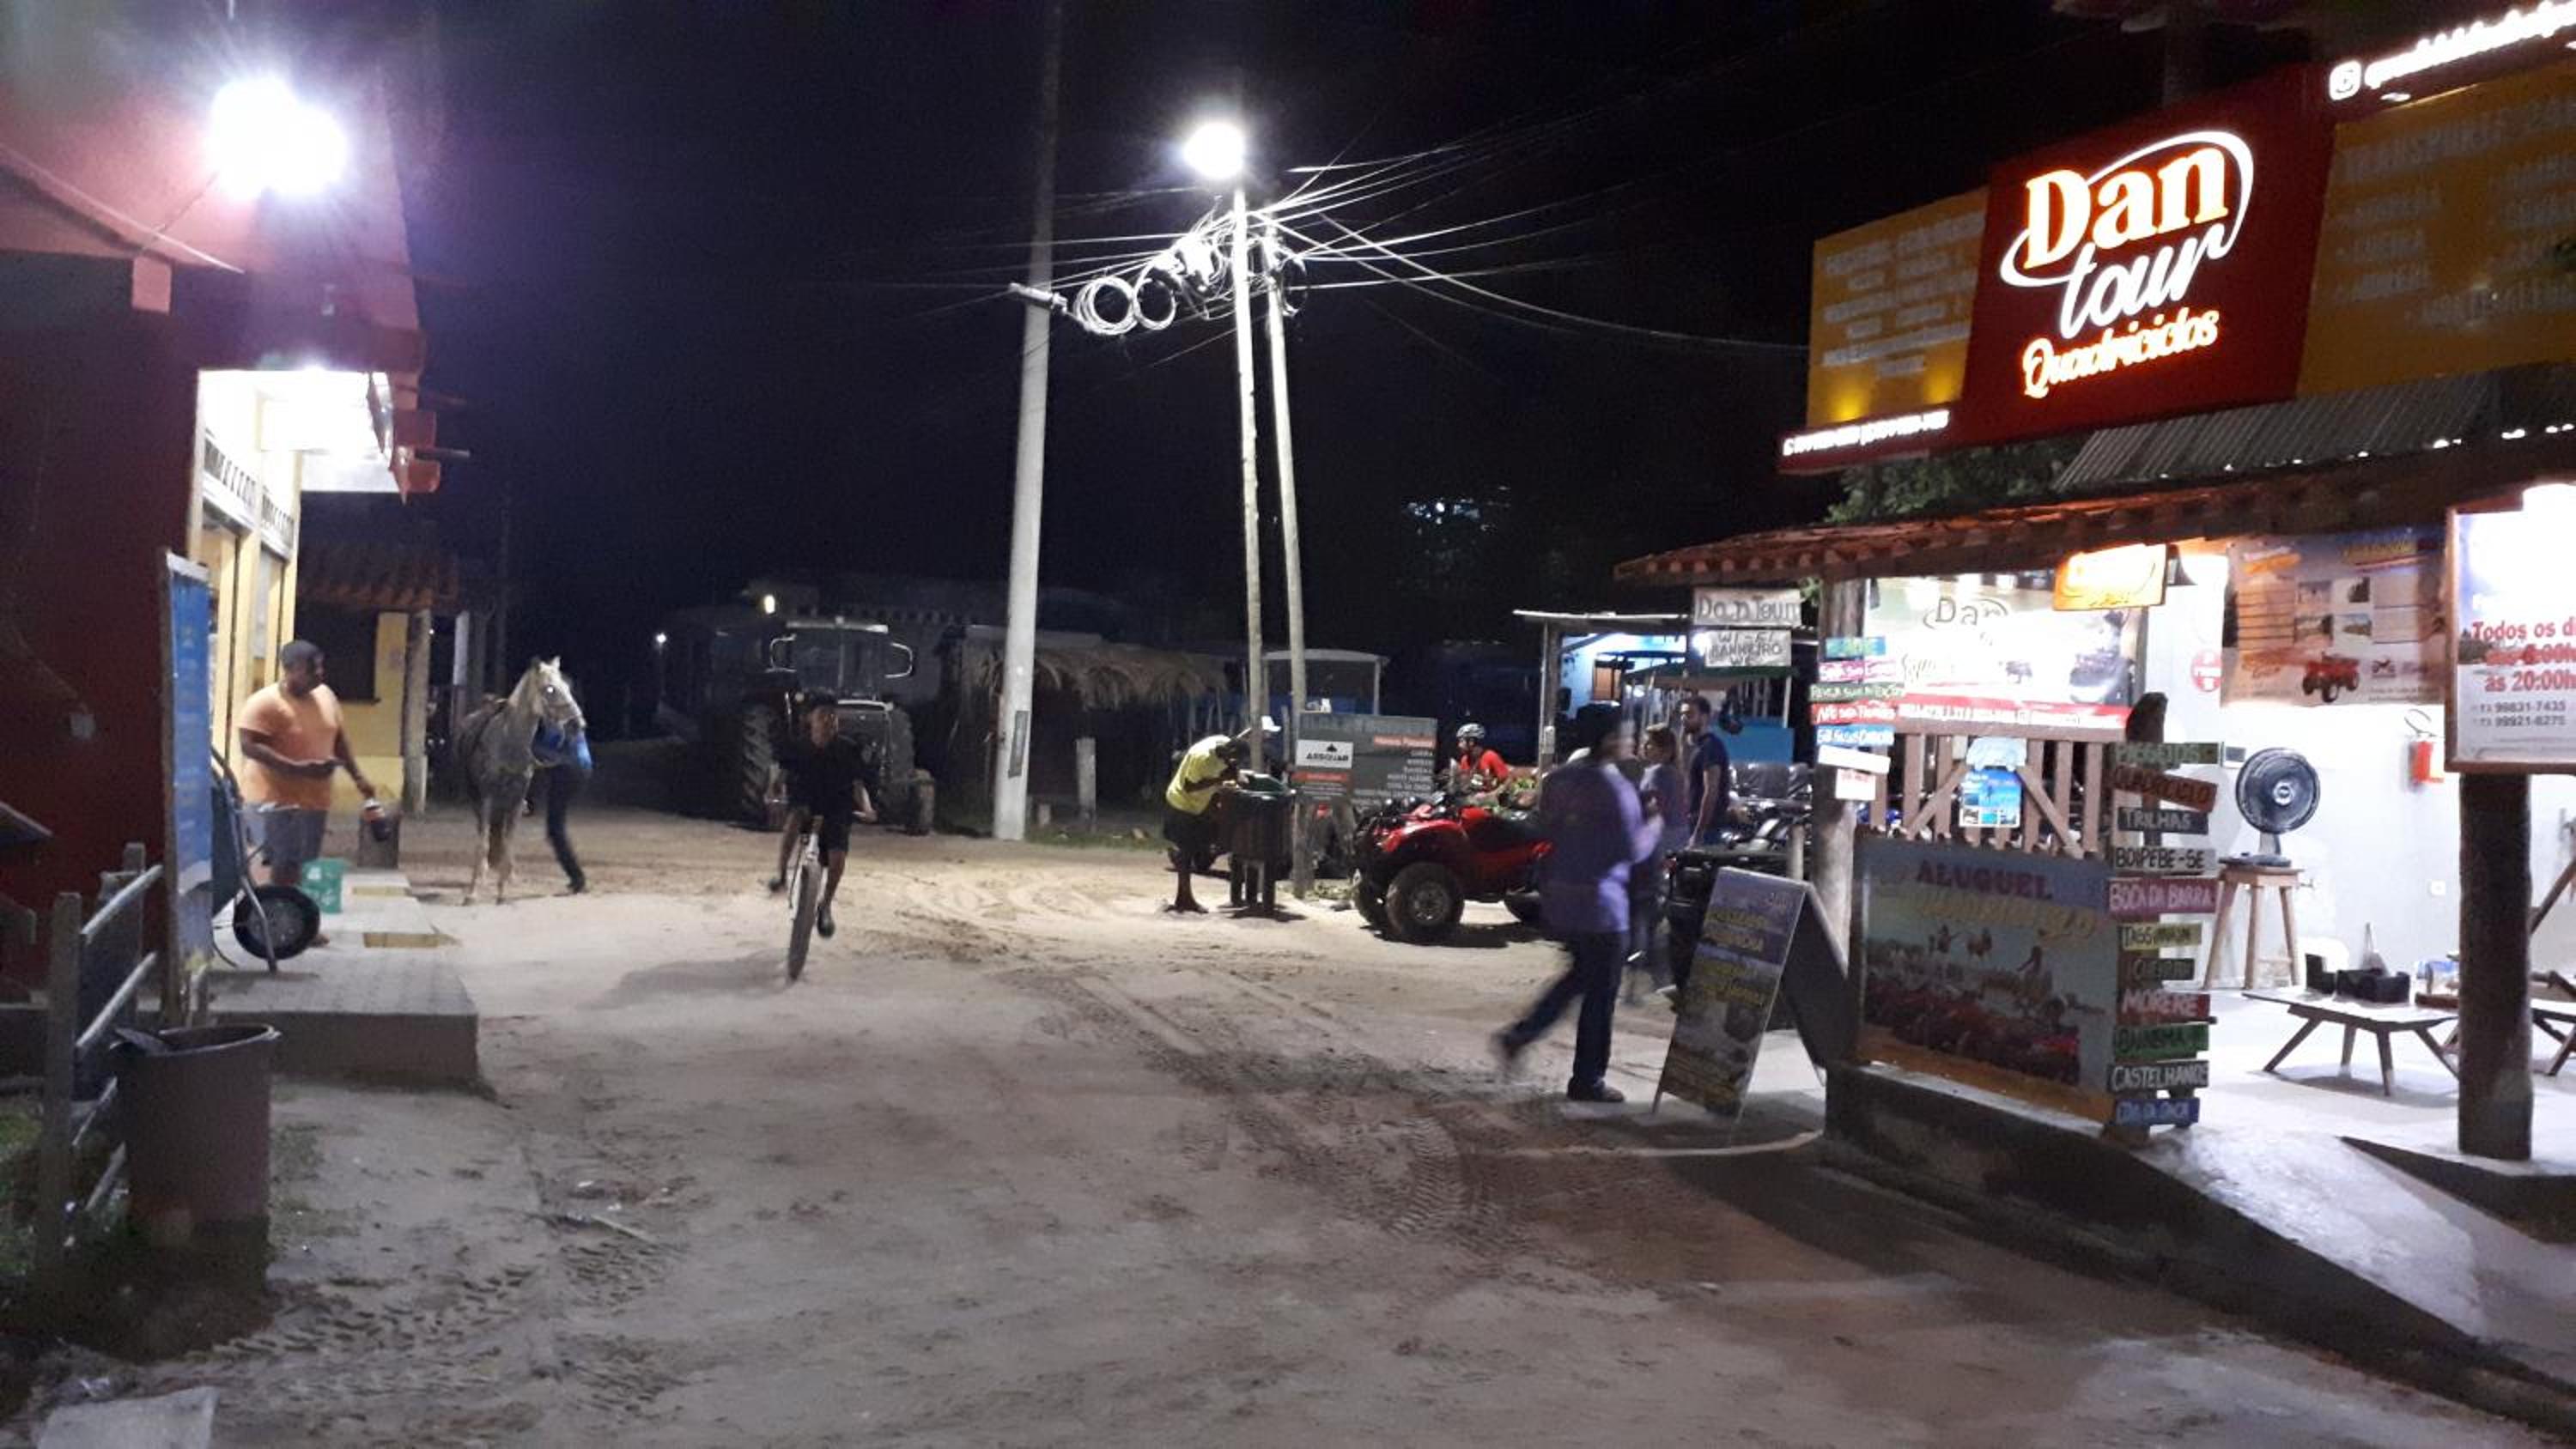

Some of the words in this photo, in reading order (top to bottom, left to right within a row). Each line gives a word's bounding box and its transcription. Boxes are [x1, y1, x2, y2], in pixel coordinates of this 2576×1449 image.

[2023, 148, 2229, 270] Dan
[2059, 222, 2233, 340] tour
[2022, 306, 2220, 398] Quadriciclos
[2472, 620, 2527, 641] Todos
[2534, 622, 2556, 639] os
[2126, 810, 2191, 829] TRILHAS
